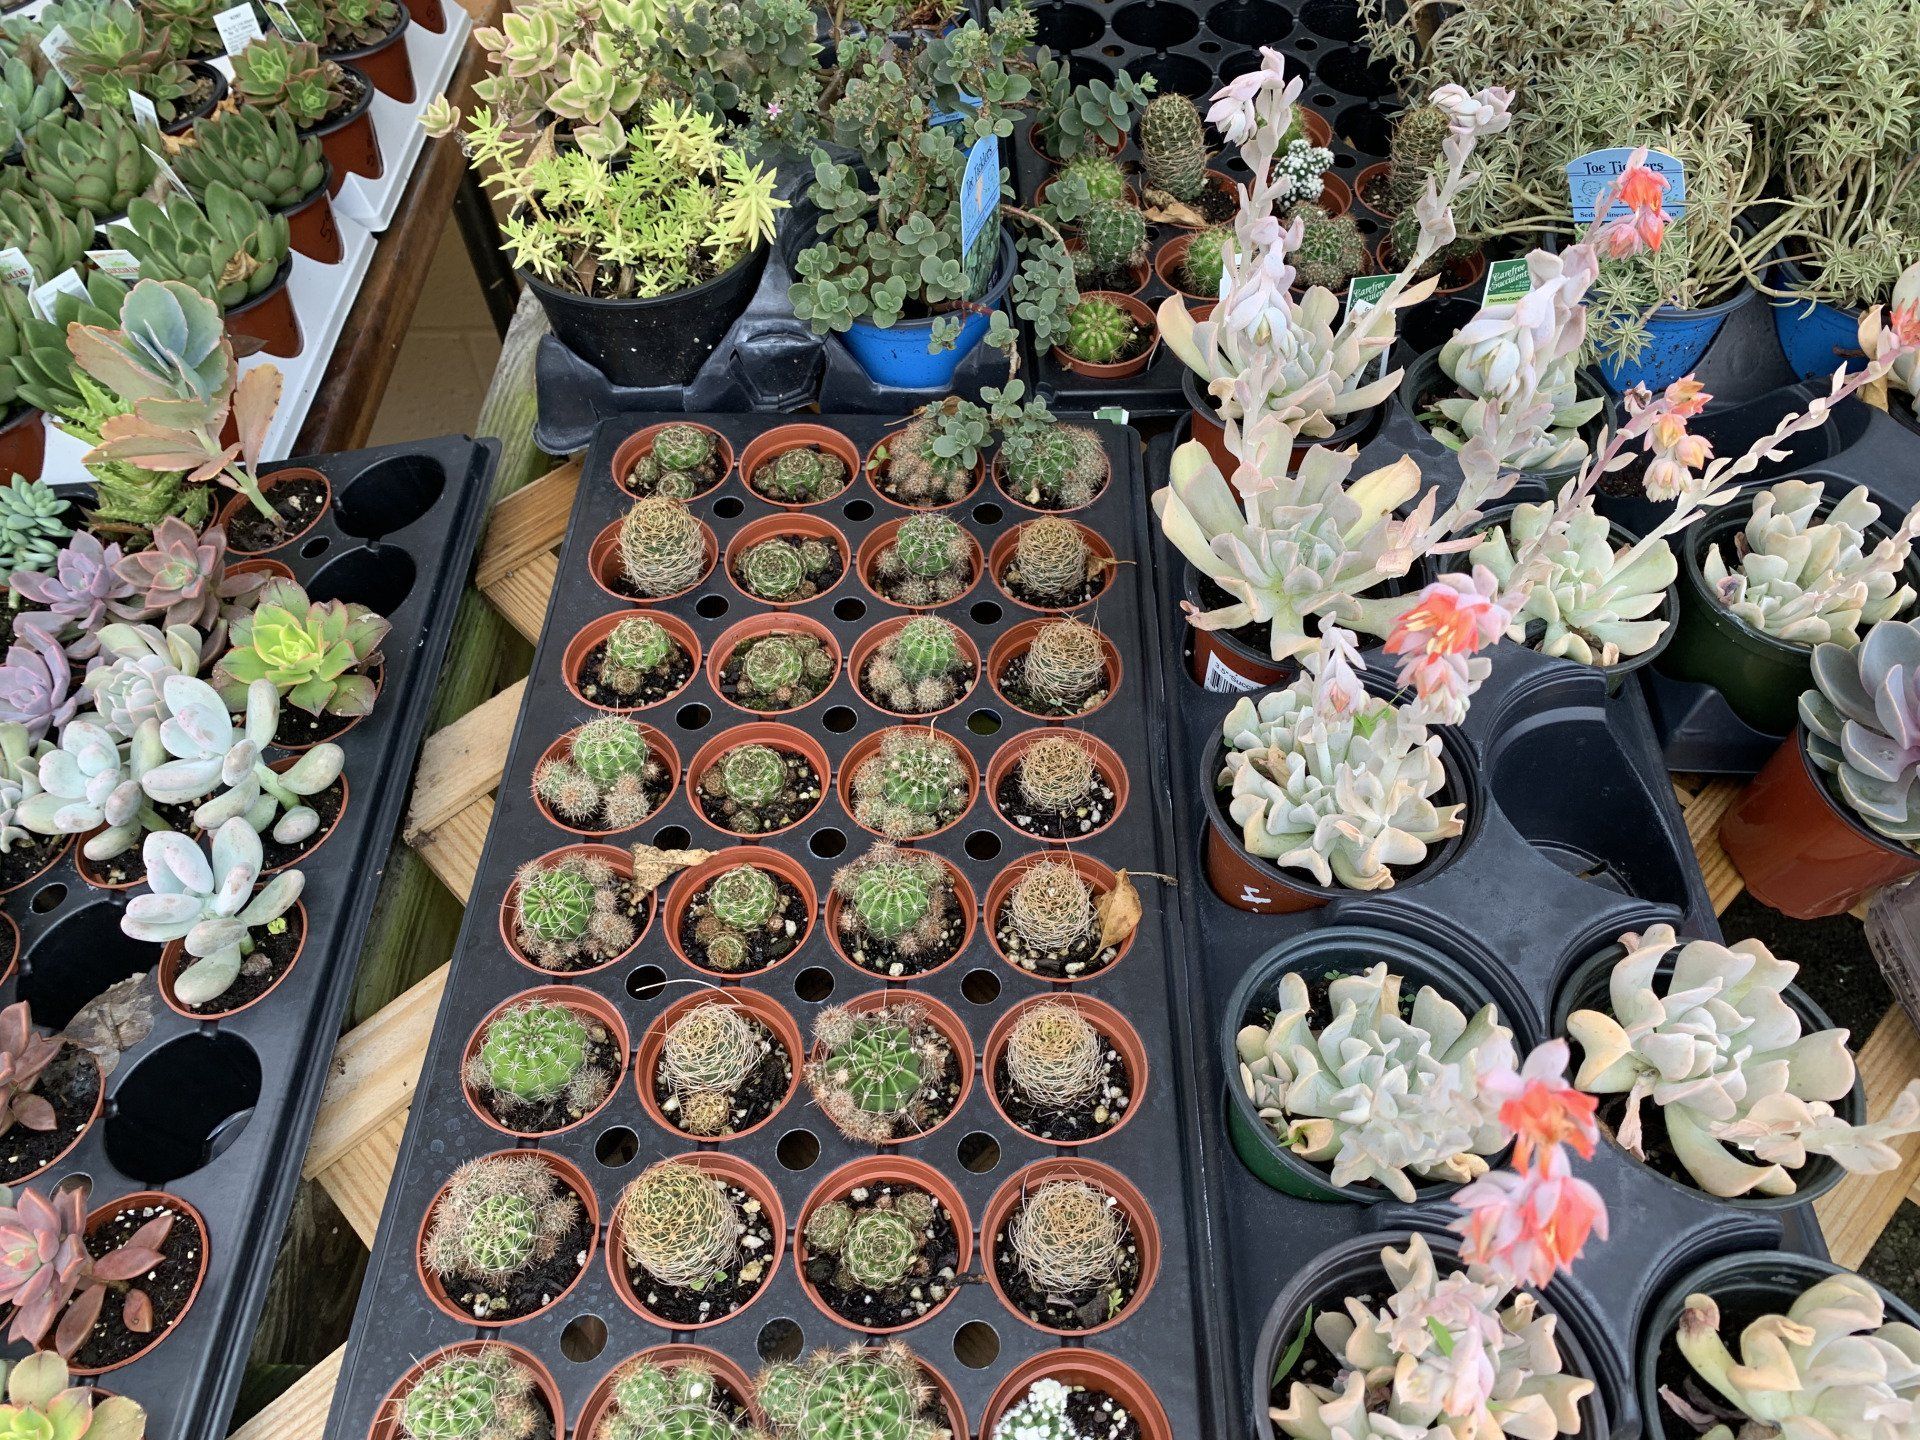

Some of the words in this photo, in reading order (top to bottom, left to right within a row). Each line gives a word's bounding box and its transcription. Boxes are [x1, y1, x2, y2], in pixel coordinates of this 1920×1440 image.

[1583, 162, 1606, 175] Toe
[1488, 270, 1529, 291] Succulent
[1492, 264, 1526, 281] Carefree
[1353, 281, 1386, 298] Carefree
